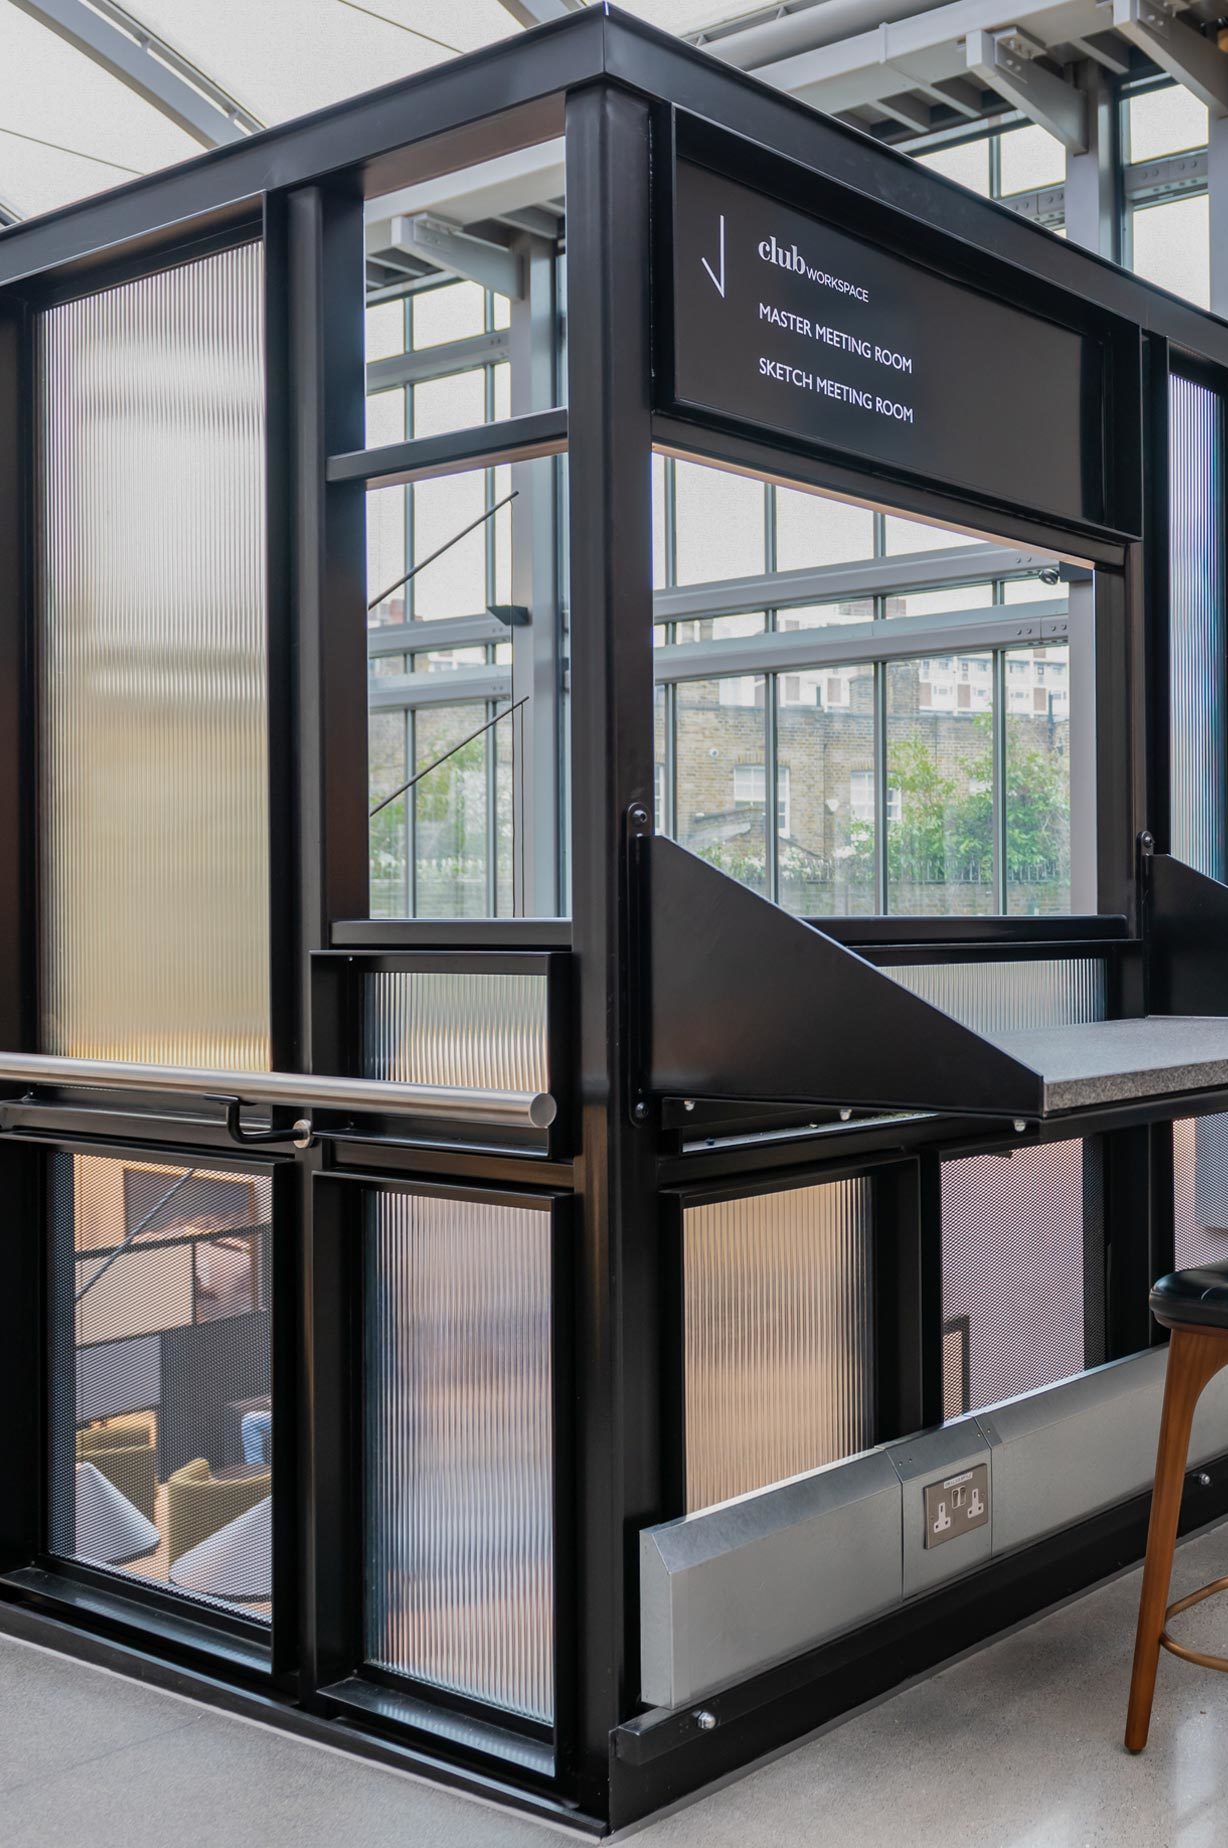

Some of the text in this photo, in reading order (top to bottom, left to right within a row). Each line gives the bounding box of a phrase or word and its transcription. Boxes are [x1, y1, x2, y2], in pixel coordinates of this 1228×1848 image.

[758, 236, 869, 302] club WORKSPACE
[759, 303, 912, 373] MASTER MEETING ROOM
[759, 358, 913, 423] SKETCH MEETING ROOM
